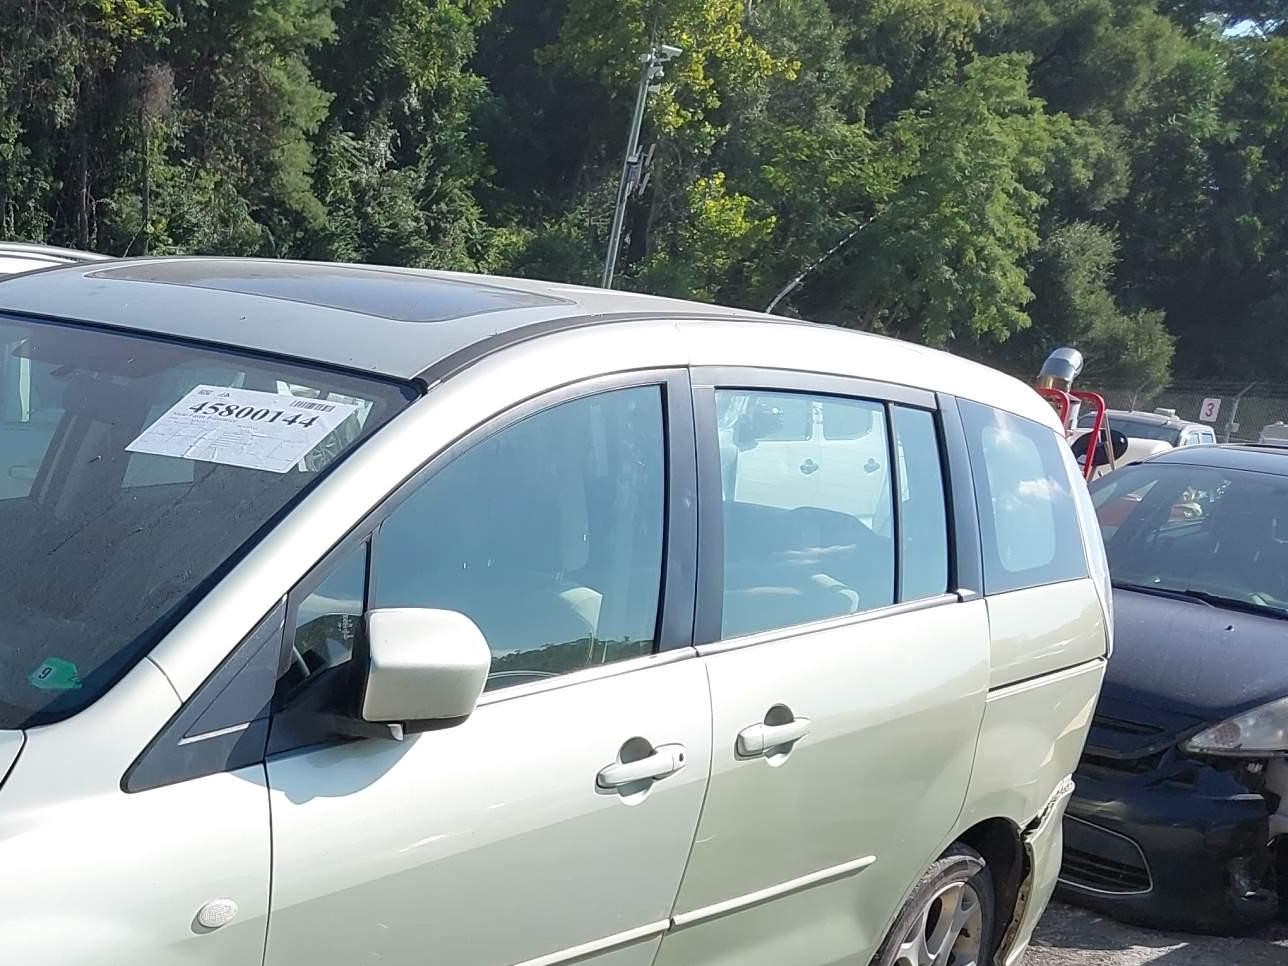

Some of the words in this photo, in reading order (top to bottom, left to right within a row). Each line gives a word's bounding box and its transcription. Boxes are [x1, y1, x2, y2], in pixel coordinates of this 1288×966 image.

[189, 401, 319, 428] 45800144
[1205, 402, 1215, 417] 3
[38, 666, 53, 680] 9
